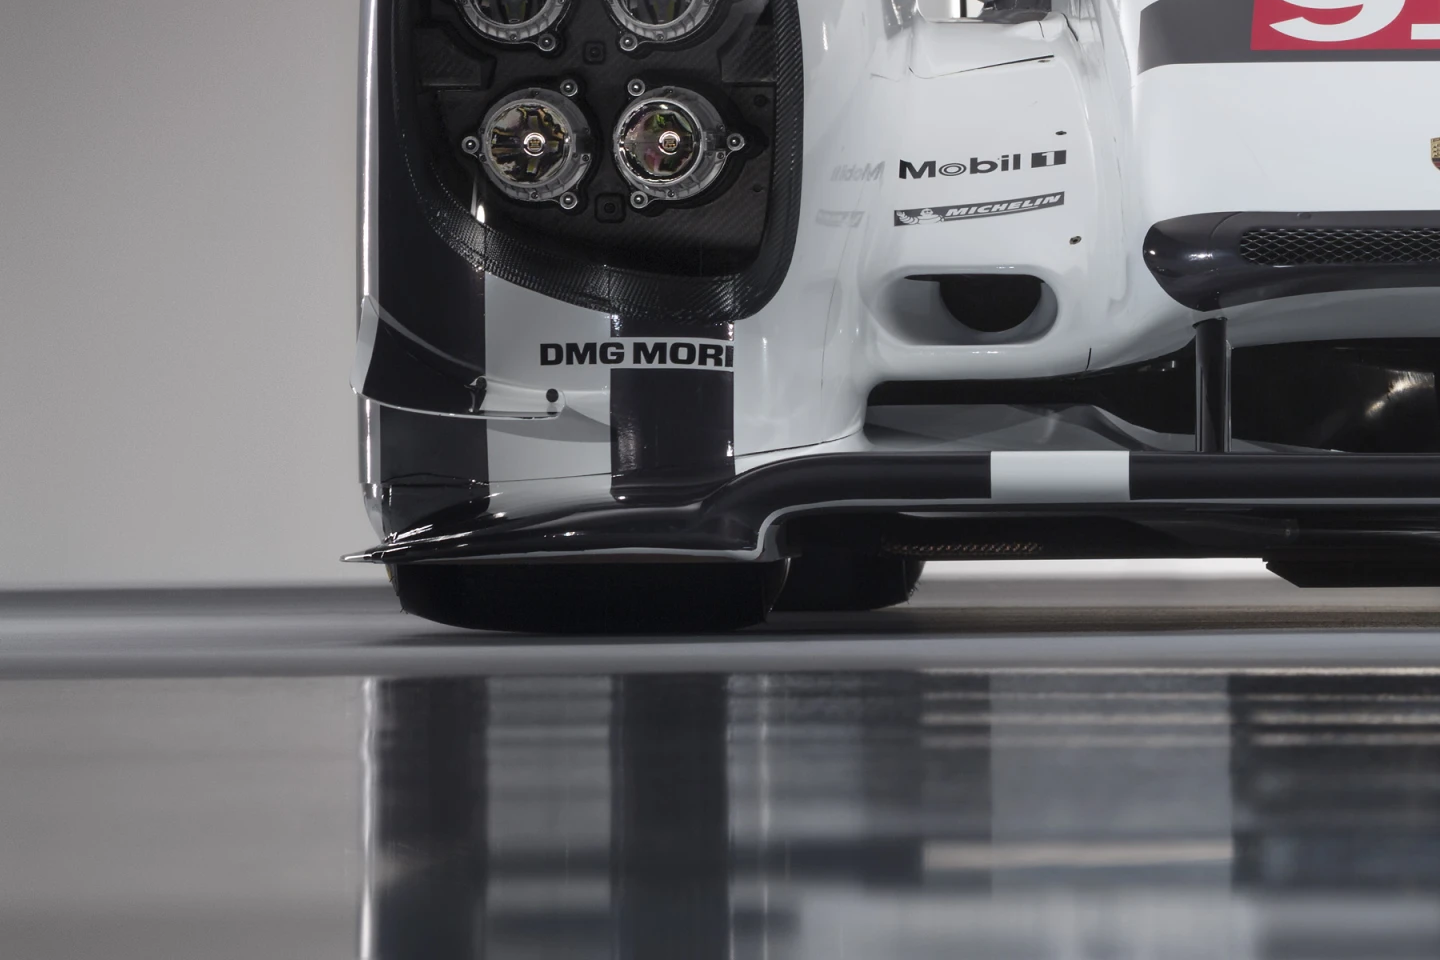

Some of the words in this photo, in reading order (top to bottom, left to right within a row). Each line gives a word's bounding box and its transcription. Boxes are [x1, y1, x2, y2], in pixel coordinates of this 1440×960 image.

[898, 152, 1022, 180] Mobil
[944, 194, 1062, 217] MICHELIN
[539, 341, 625, 366] DMG
[632, 341, 734, 368] MORI
